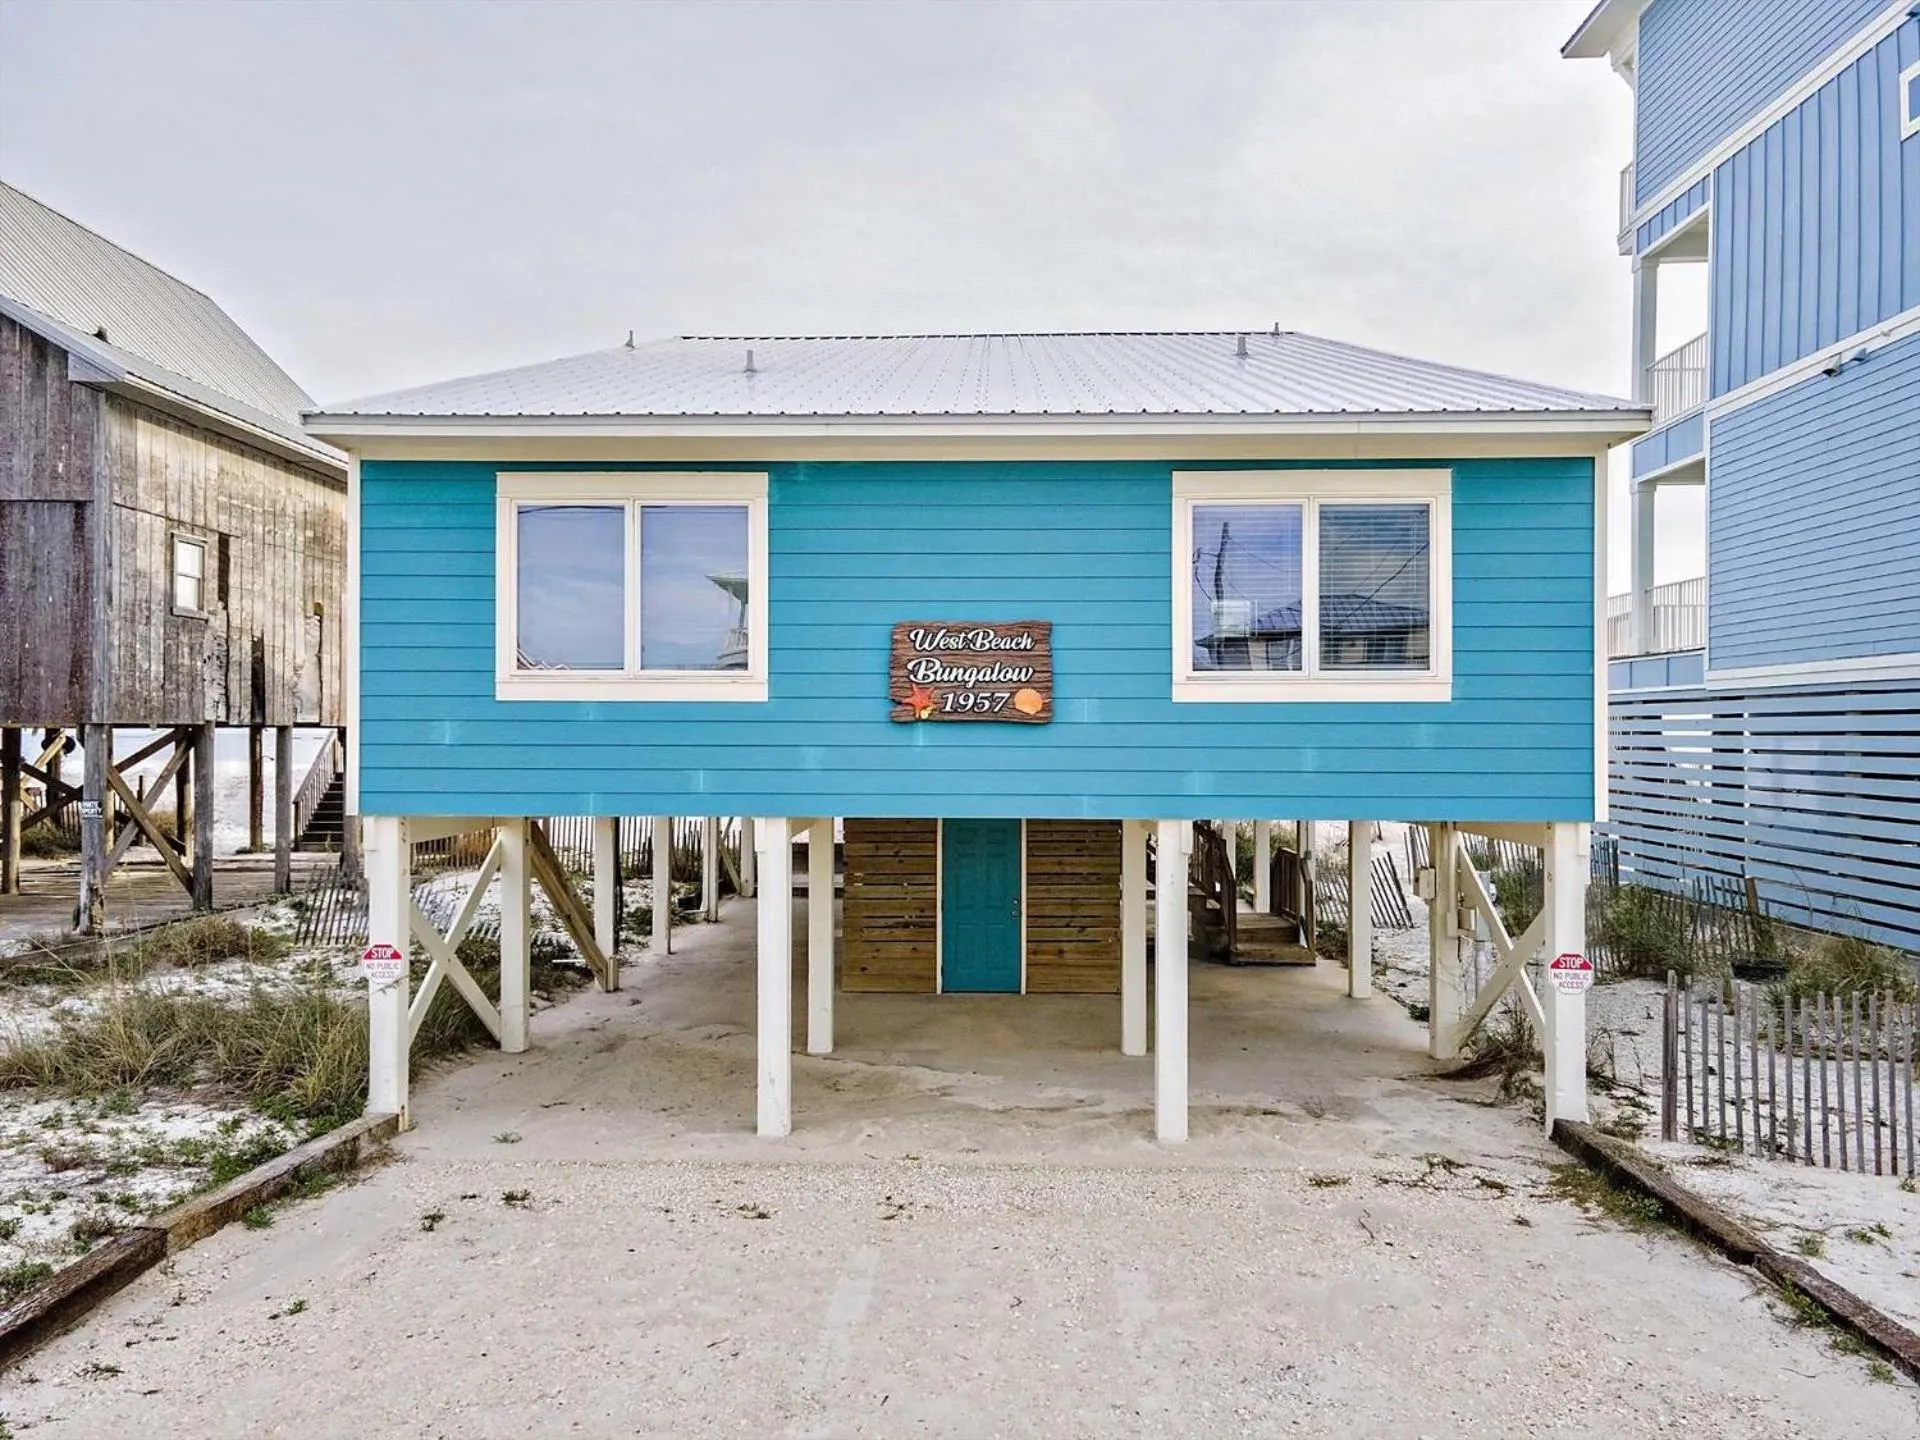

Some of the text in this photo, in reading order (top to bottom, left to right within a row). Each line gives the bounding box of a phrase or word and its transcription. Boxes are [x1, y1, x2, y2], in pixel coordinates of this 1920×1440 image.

[909, 629, 1034, 651] West Beach
[906, 657, 1034, 688] Bungalow
[941, 692, 1010, 713] 1957
[371, 947, 394, 959] STOP
[366, 962, 400, 970] NO PUBLIC
[1559, 957, 1584, 969] STOP
[371, 971, 394, 979] ACCESS
[1553, 972, 1589, 981] NO PUBLIC
[1558, 981, 1584, 989] ACCESS
